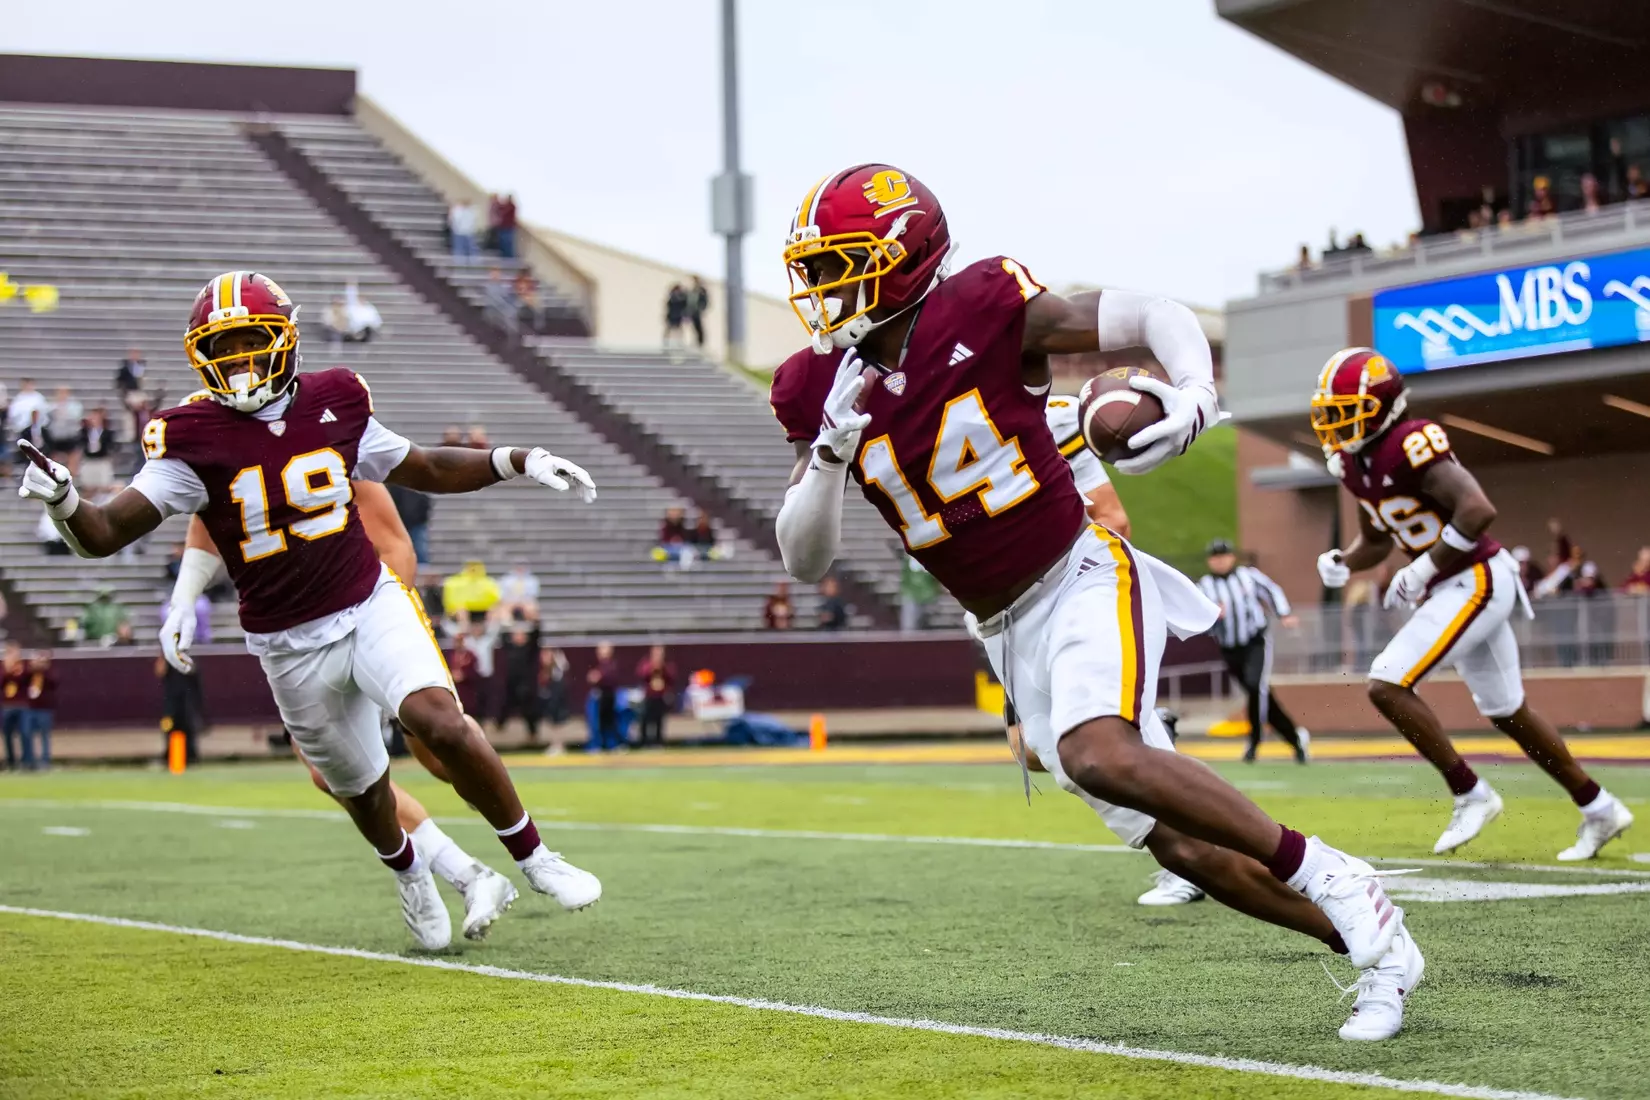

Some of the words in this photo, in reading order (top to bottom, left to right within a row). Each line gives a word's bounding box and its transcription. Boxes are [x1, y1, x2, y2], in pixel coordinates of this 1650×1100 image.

[1496, 261, 1593, 334] MBS
[141, 418, 168, 460] 9
[860, 387, 1040, 550] 14
[1402, 423, 1449, 469] 26
[230, 447, 353, 563] 19
